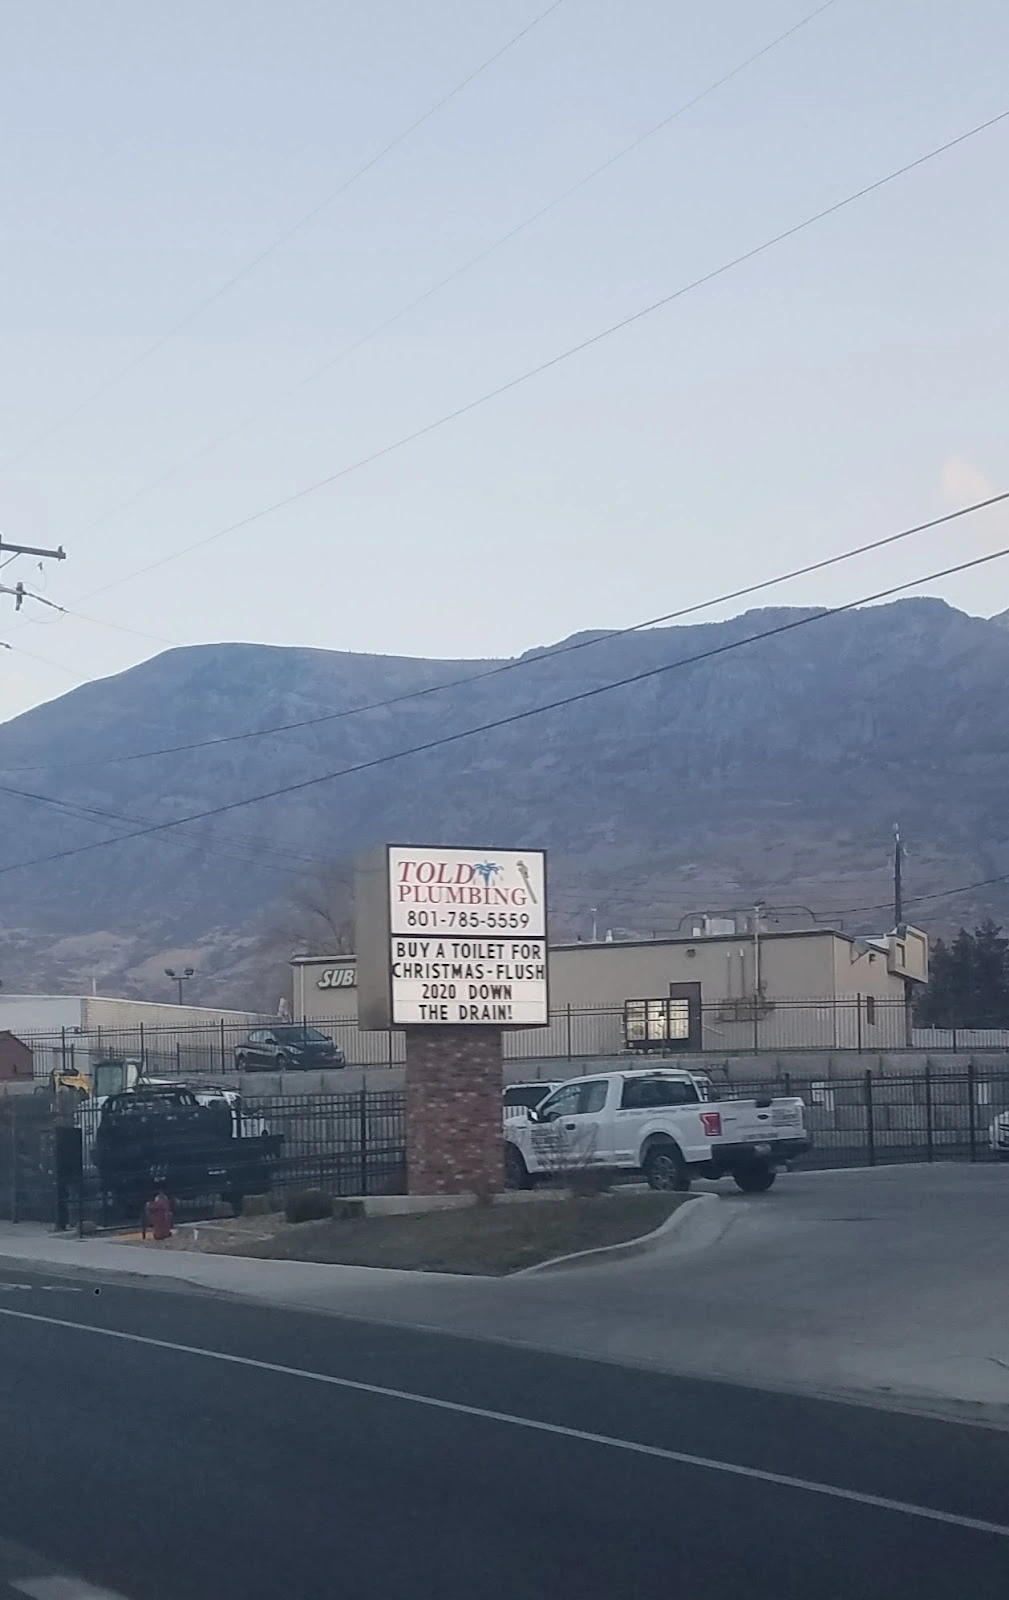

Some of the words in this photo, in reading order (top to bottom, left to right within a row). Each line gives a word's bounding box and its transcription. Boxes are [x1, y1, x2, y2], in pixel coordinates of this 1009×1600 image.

[398, 861, 474, 883] TOLD
[397, 885, 527, 905] PLUMBING
[407, 910, 530, 928] 801-785-5559
[396, 942, 430, 957] BUY
[436, 943, 447, 958] A
[452, 943, 504, 960] TOILET
[511, 944, 542, 960] FOR
[318, 969, 355, 988] SUB
[422, 984, 456, 1000] 2020
[469, 985, 512, 1000] DOWN
[419, 1004, 448, 1020] THE
[459, 1005, 513, 1020] DRAIN!
